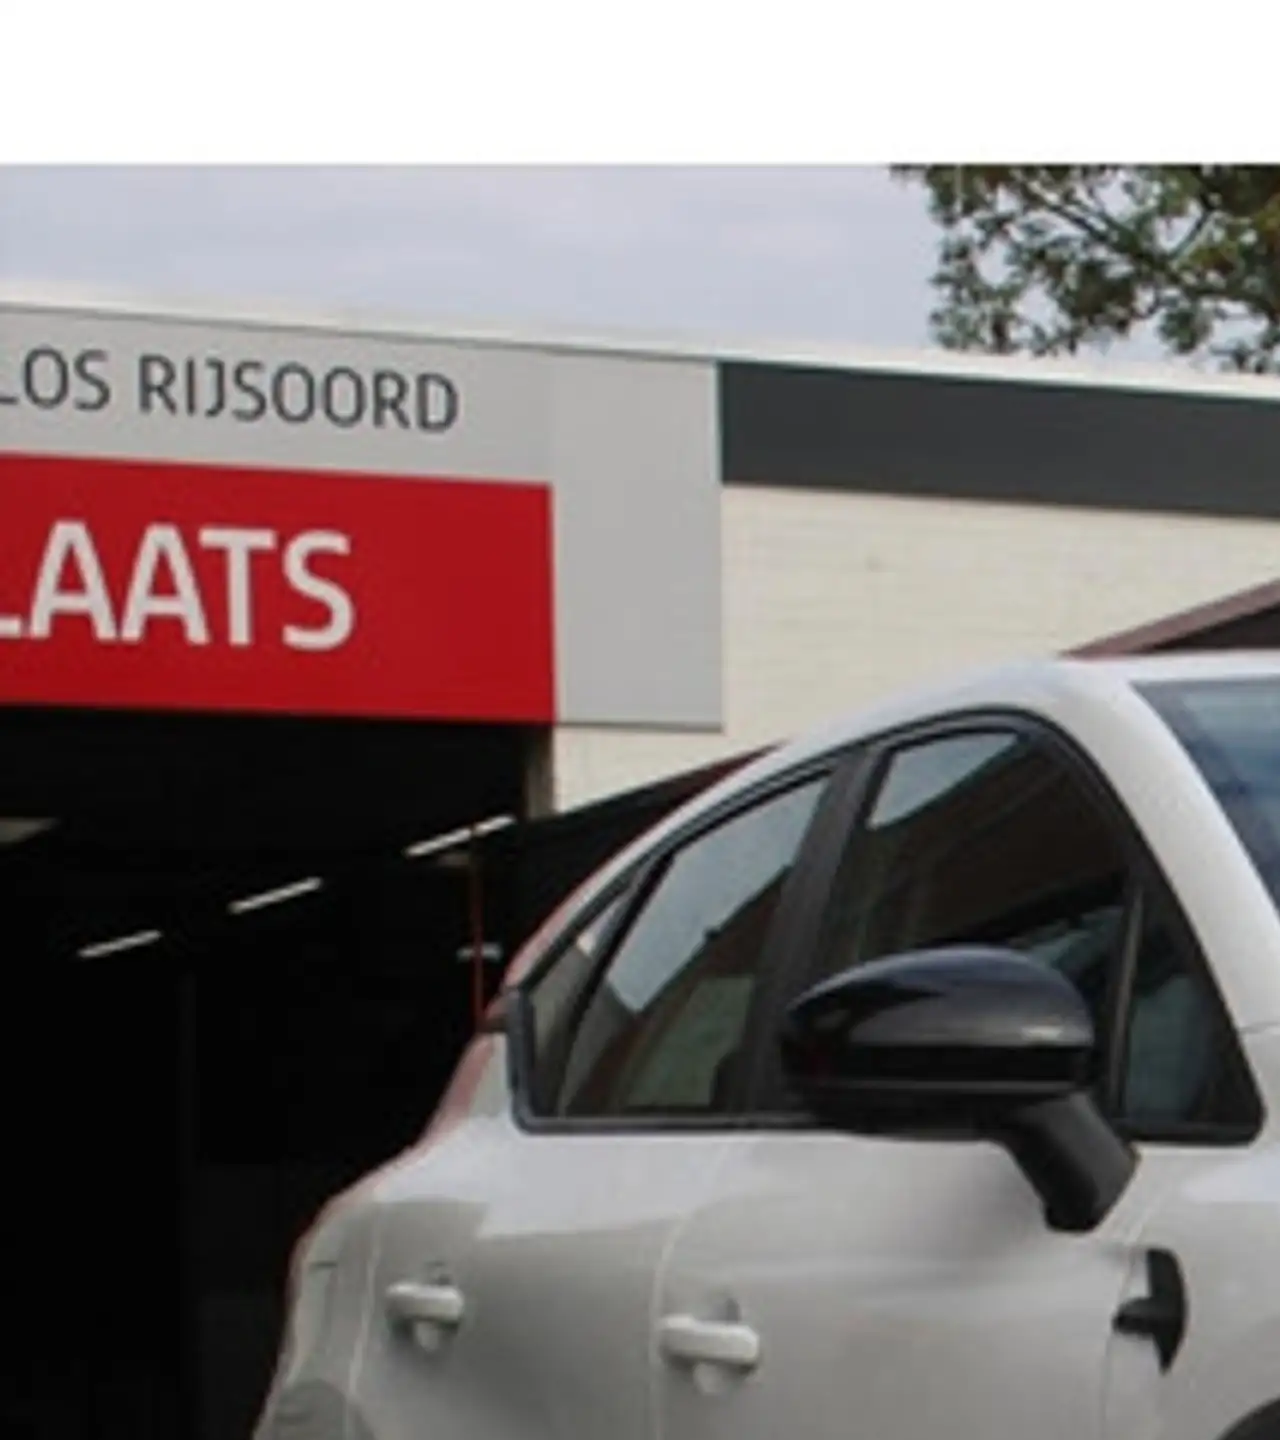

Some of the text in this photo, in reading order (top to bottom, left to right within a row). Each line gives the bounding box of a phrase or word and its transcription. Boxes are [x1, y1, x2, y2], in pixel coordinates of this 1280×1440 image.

[0, 346, 460, 433] OS RIJSOORD
[0, 520, 356, 651] AATS
